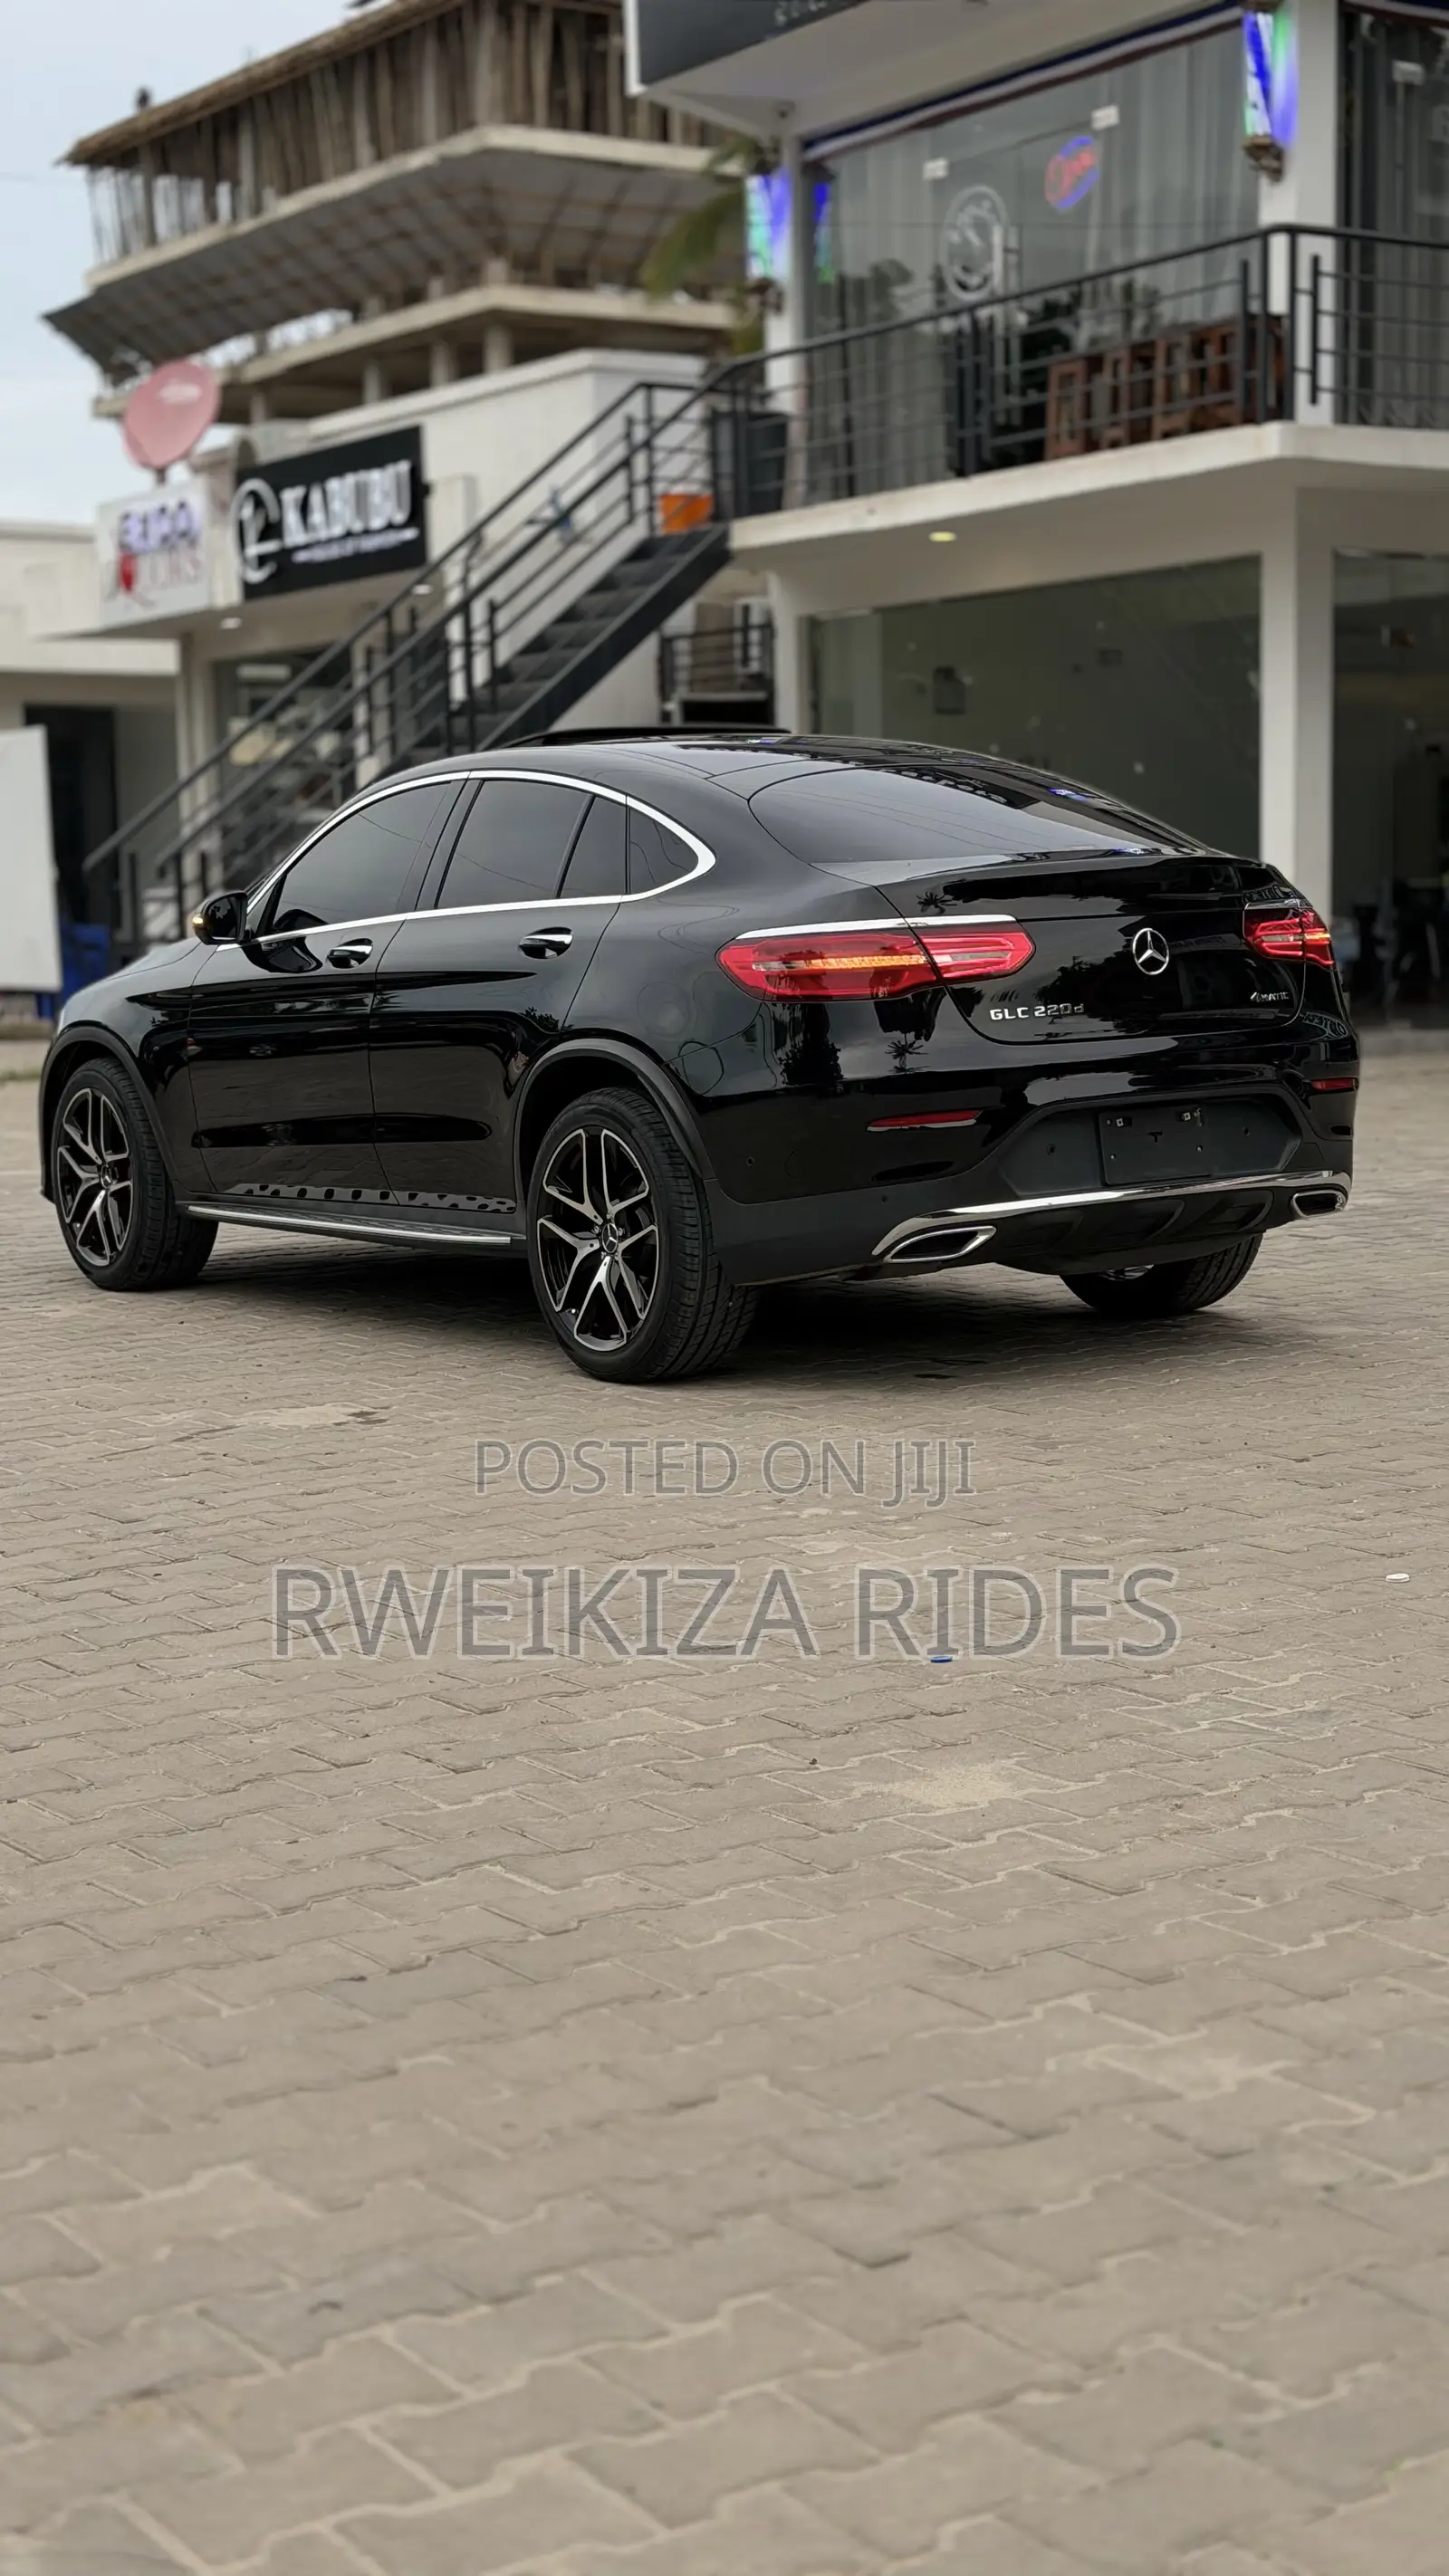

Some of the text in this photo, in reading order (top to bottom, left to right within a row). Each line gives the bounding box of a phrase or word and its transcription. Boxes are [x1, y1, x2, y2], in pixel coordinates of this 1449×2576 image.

[279, 459, 411, 549] KABUBU
[989, 1002, 1084, 1020] GLC 220d
